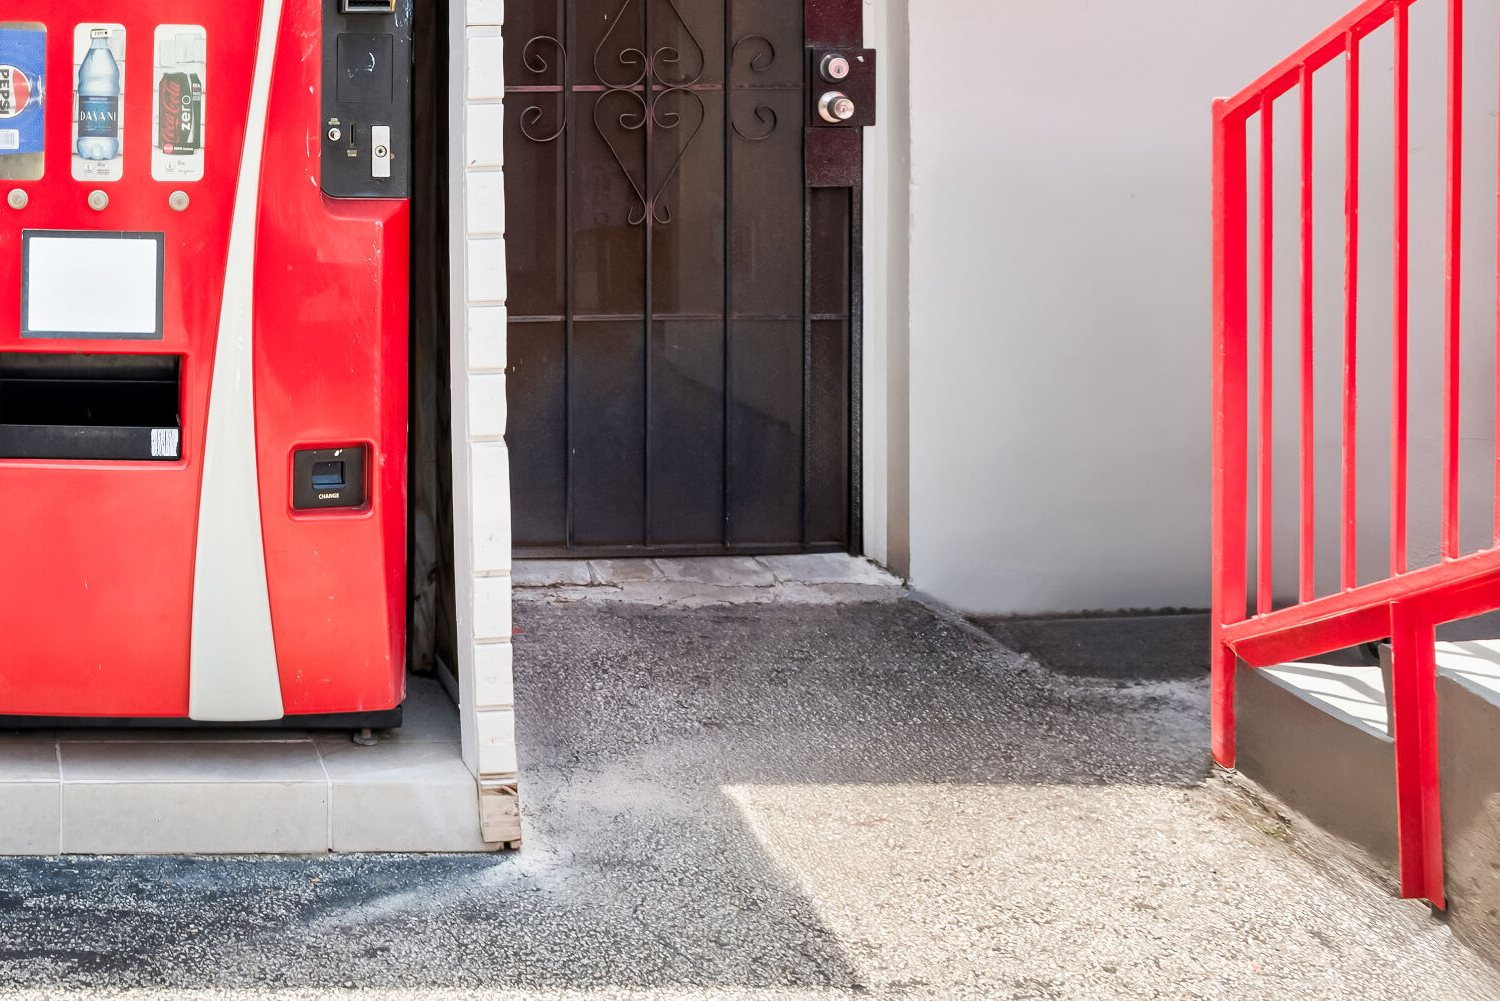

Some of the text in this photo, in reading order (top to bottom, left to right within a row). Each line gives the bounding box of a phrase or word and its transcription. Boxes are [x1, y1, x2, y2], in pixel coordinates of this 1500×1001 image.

[0, 69, 10, 115] PEPSI
[80, 110, 116, 122] DASANI
[181, 94, 192, 131] zero
[318, 492, 340, 500] CHANGE
